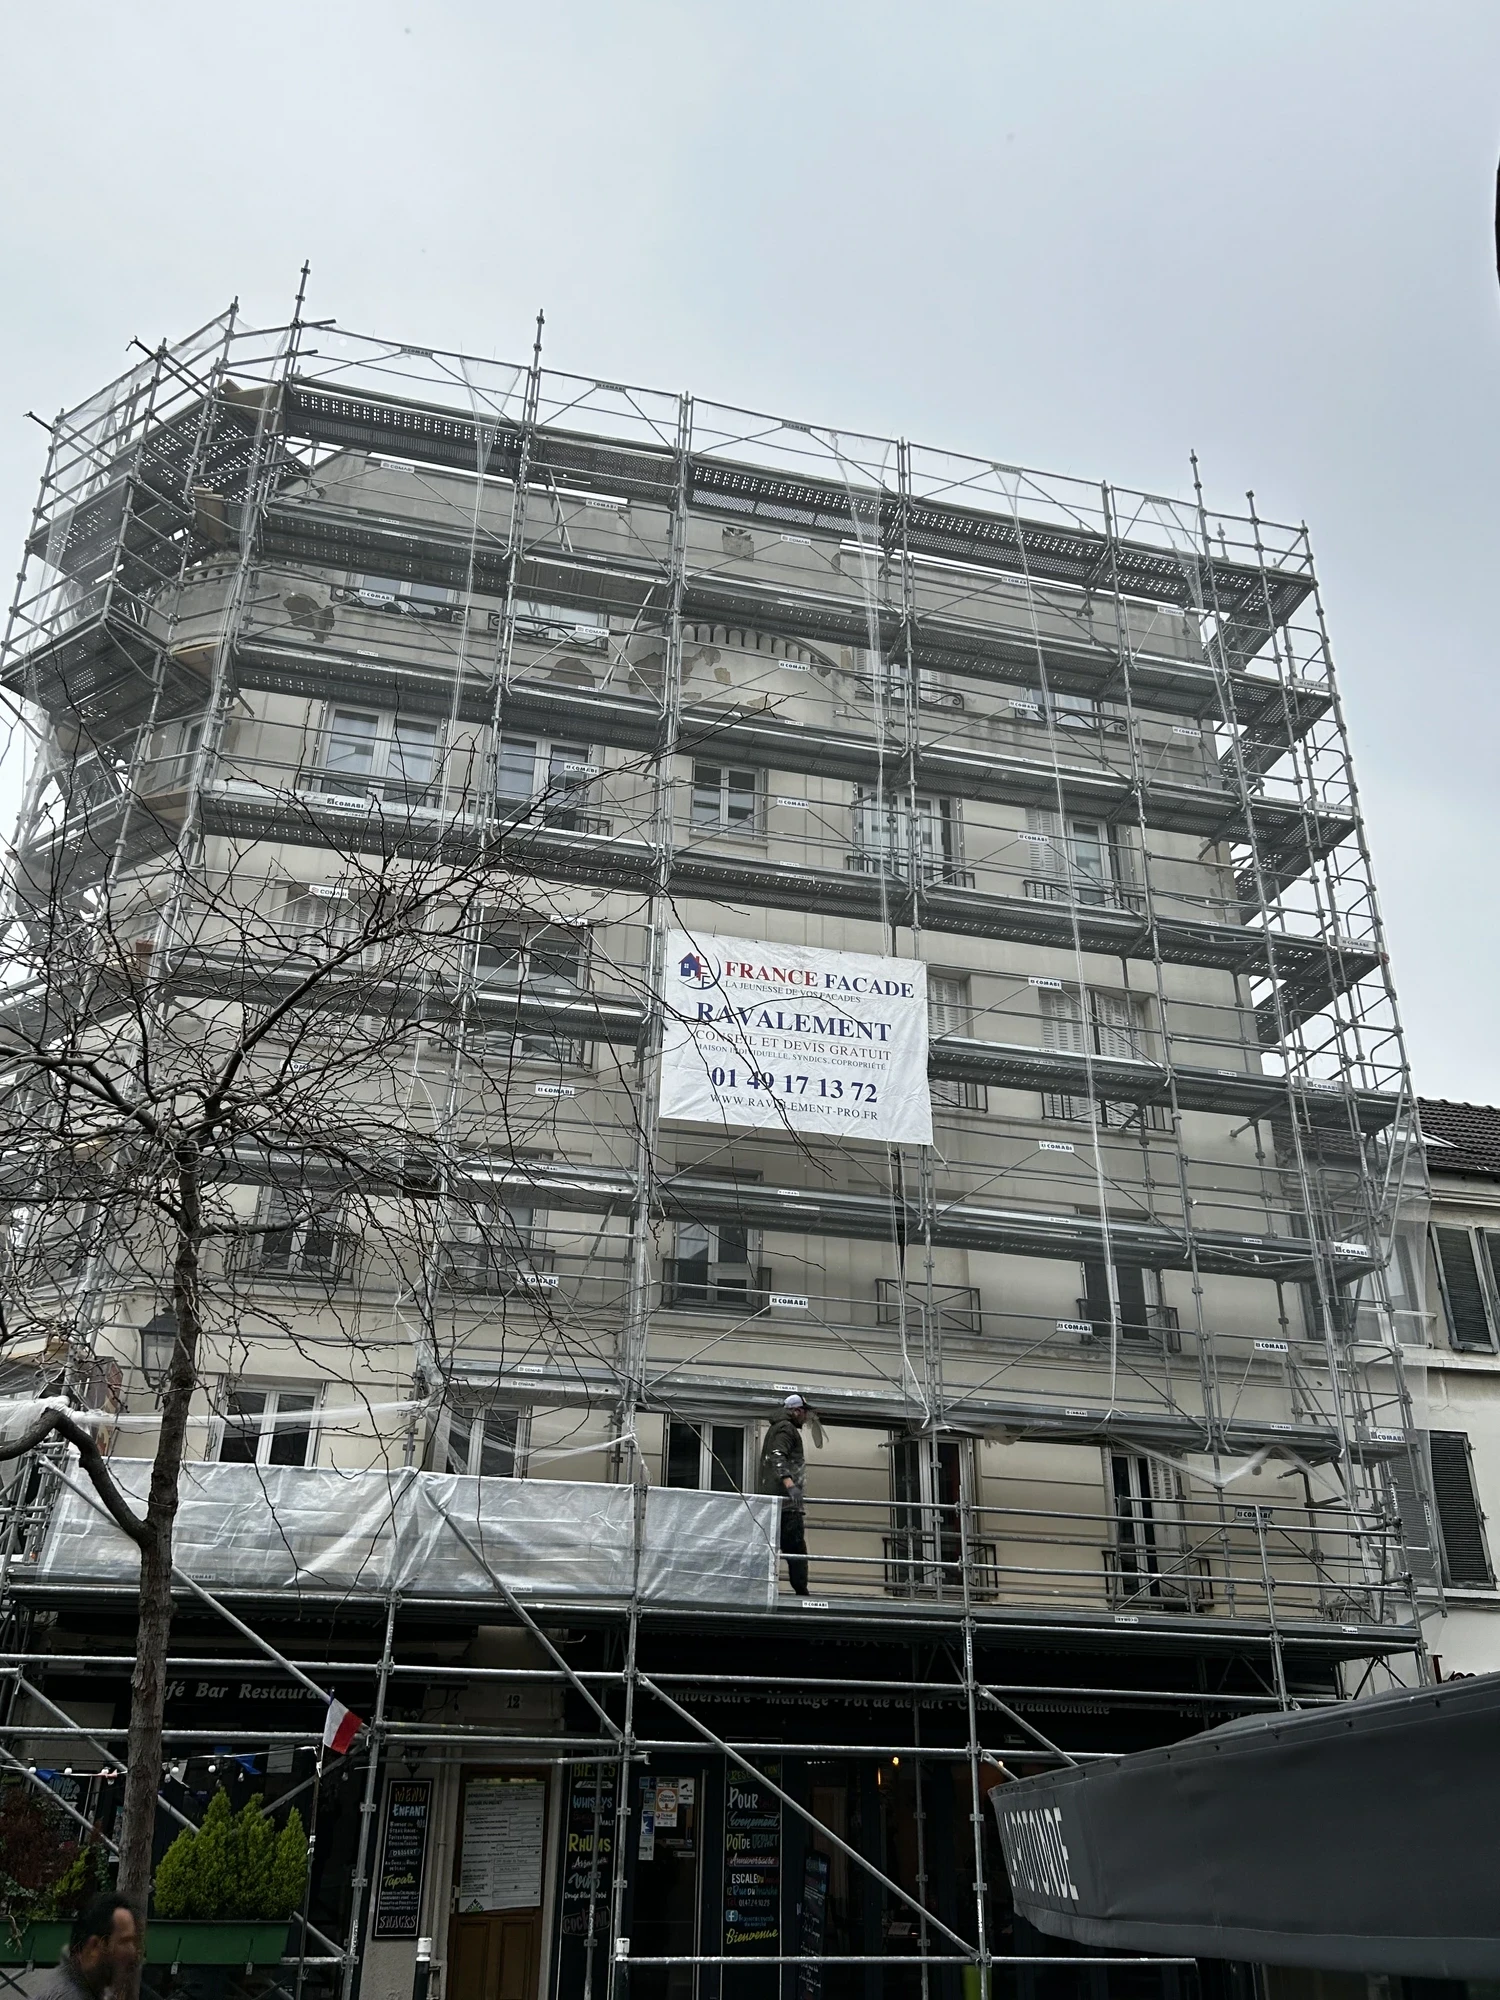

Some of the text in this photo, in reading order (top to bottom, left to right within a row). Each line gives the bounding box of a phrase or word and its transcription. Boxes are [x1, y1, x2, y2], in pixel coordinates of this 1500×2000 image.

[390, 463, 414, 472] COMABI
[366, 592, 394, 601] COMABI
[584, 628, 608, 637] COMABI
[785, 663, 808, 672] COMABI
[1014, 701, 1037, 710] COMABI
[1180, 728, 1200, 736] COMABI
[571, 765, 597, 774] COMABI
[334, 800, 364, 809] COMABI
[784, 799, 808, 807] COMABI
[1024, 835, 1048, 843] COMABI
[725, 960, 915, 998] FRANCE FACADE
[1035, 979, 1060, 988] COMABI
[725, 981, 737, 989] LA
[740, 981, 783, 994] JEUNESSE
[800, 990, 817, 998] VOS
[820, 992, 860, 1003] FACADES
[697, 1002, 892, 1042] RAVALEMENT
[696, 1029, 892, 1061] CONSEIL ET DEVIS GRATUIT
[729, 1047, 790, 1061] INDIIDUELLE,
[831, 1058, 887, 1071] COPROPRIÉTÉ
[712, 1066, 878, 1103] 01 49 17 13 72
[1314, 1082, 1338, 1091] COMABI
[545, 1087, 573, 1096] COMABI
[710, 1093, 878, 1121] WWW.RAVLEMENT-PRO.FR
[1046, 1143, 1073, 1151] COMABI
[1342, 1248, 1368, 1256] COMABI
[526, 1277, 556, 1286] COMABI
[778, 1298, 806, 1307] COMABI
[1063, 1323, 1091, 1332] COMABI
[1261, 1342, 1287, 1351] COMABI
[1377, 1433, 1404, 1442] COMABI
[1243, 1511, 1271, 1520] COMABI
[195, 1681, 229, 1699] Bar
[238, 1682, 329, 1701] Restaura
[507, 1694, 520, 1709] 12
[572, 1794, 613, 1809] WHISYS
[727, 1786, 759, 1809] POUR
[392, 1803, 427, 1817] ENFANT
[726, 1833, 743, 1851] POT
[1010, 1806, 1080, 1901] ROTONDE
[726, 1928, 780, 1945] Bienvenue
